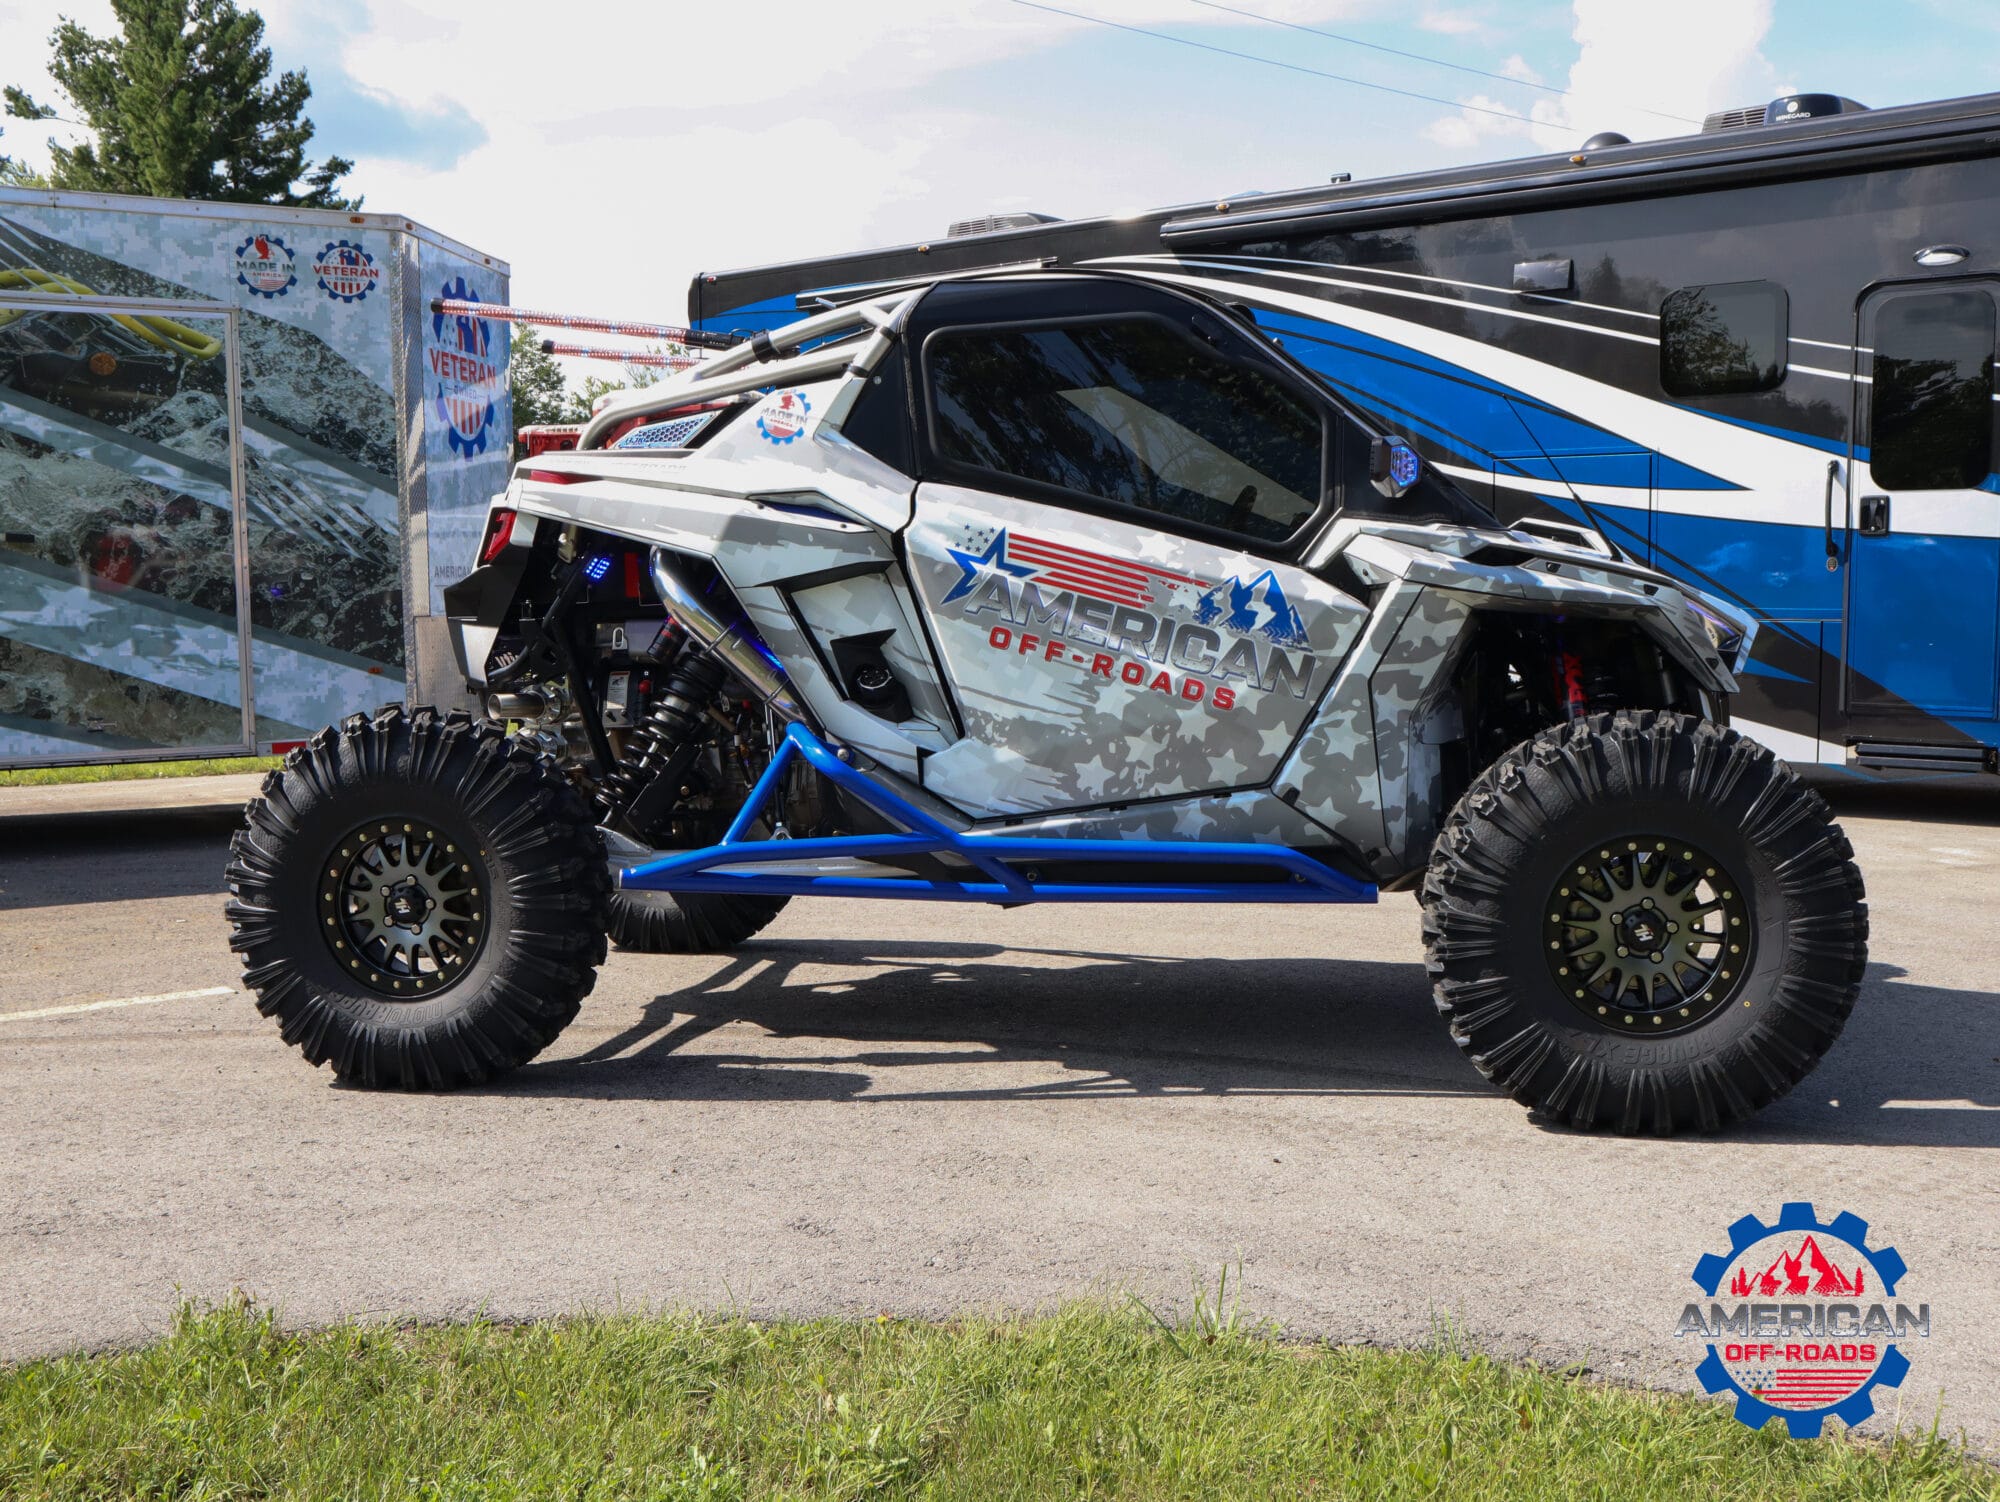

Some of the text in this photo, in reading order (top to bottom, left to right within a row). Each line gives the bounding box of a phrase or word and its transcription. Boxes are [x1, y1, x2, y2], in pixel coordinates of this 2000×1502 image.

[1776, 112, 1811, 121] WINEGARD
[236, 260, 296, 273] MADE IN
[313, 265, 379, 278] VETERAN
[429, 347, 497, 389] VETERAN
[761, 407, 808, 425] MADE IN
[965, 573, 1316, 699] AMERICAN
[989, 626, 1236, 711] OFF-ROADS
